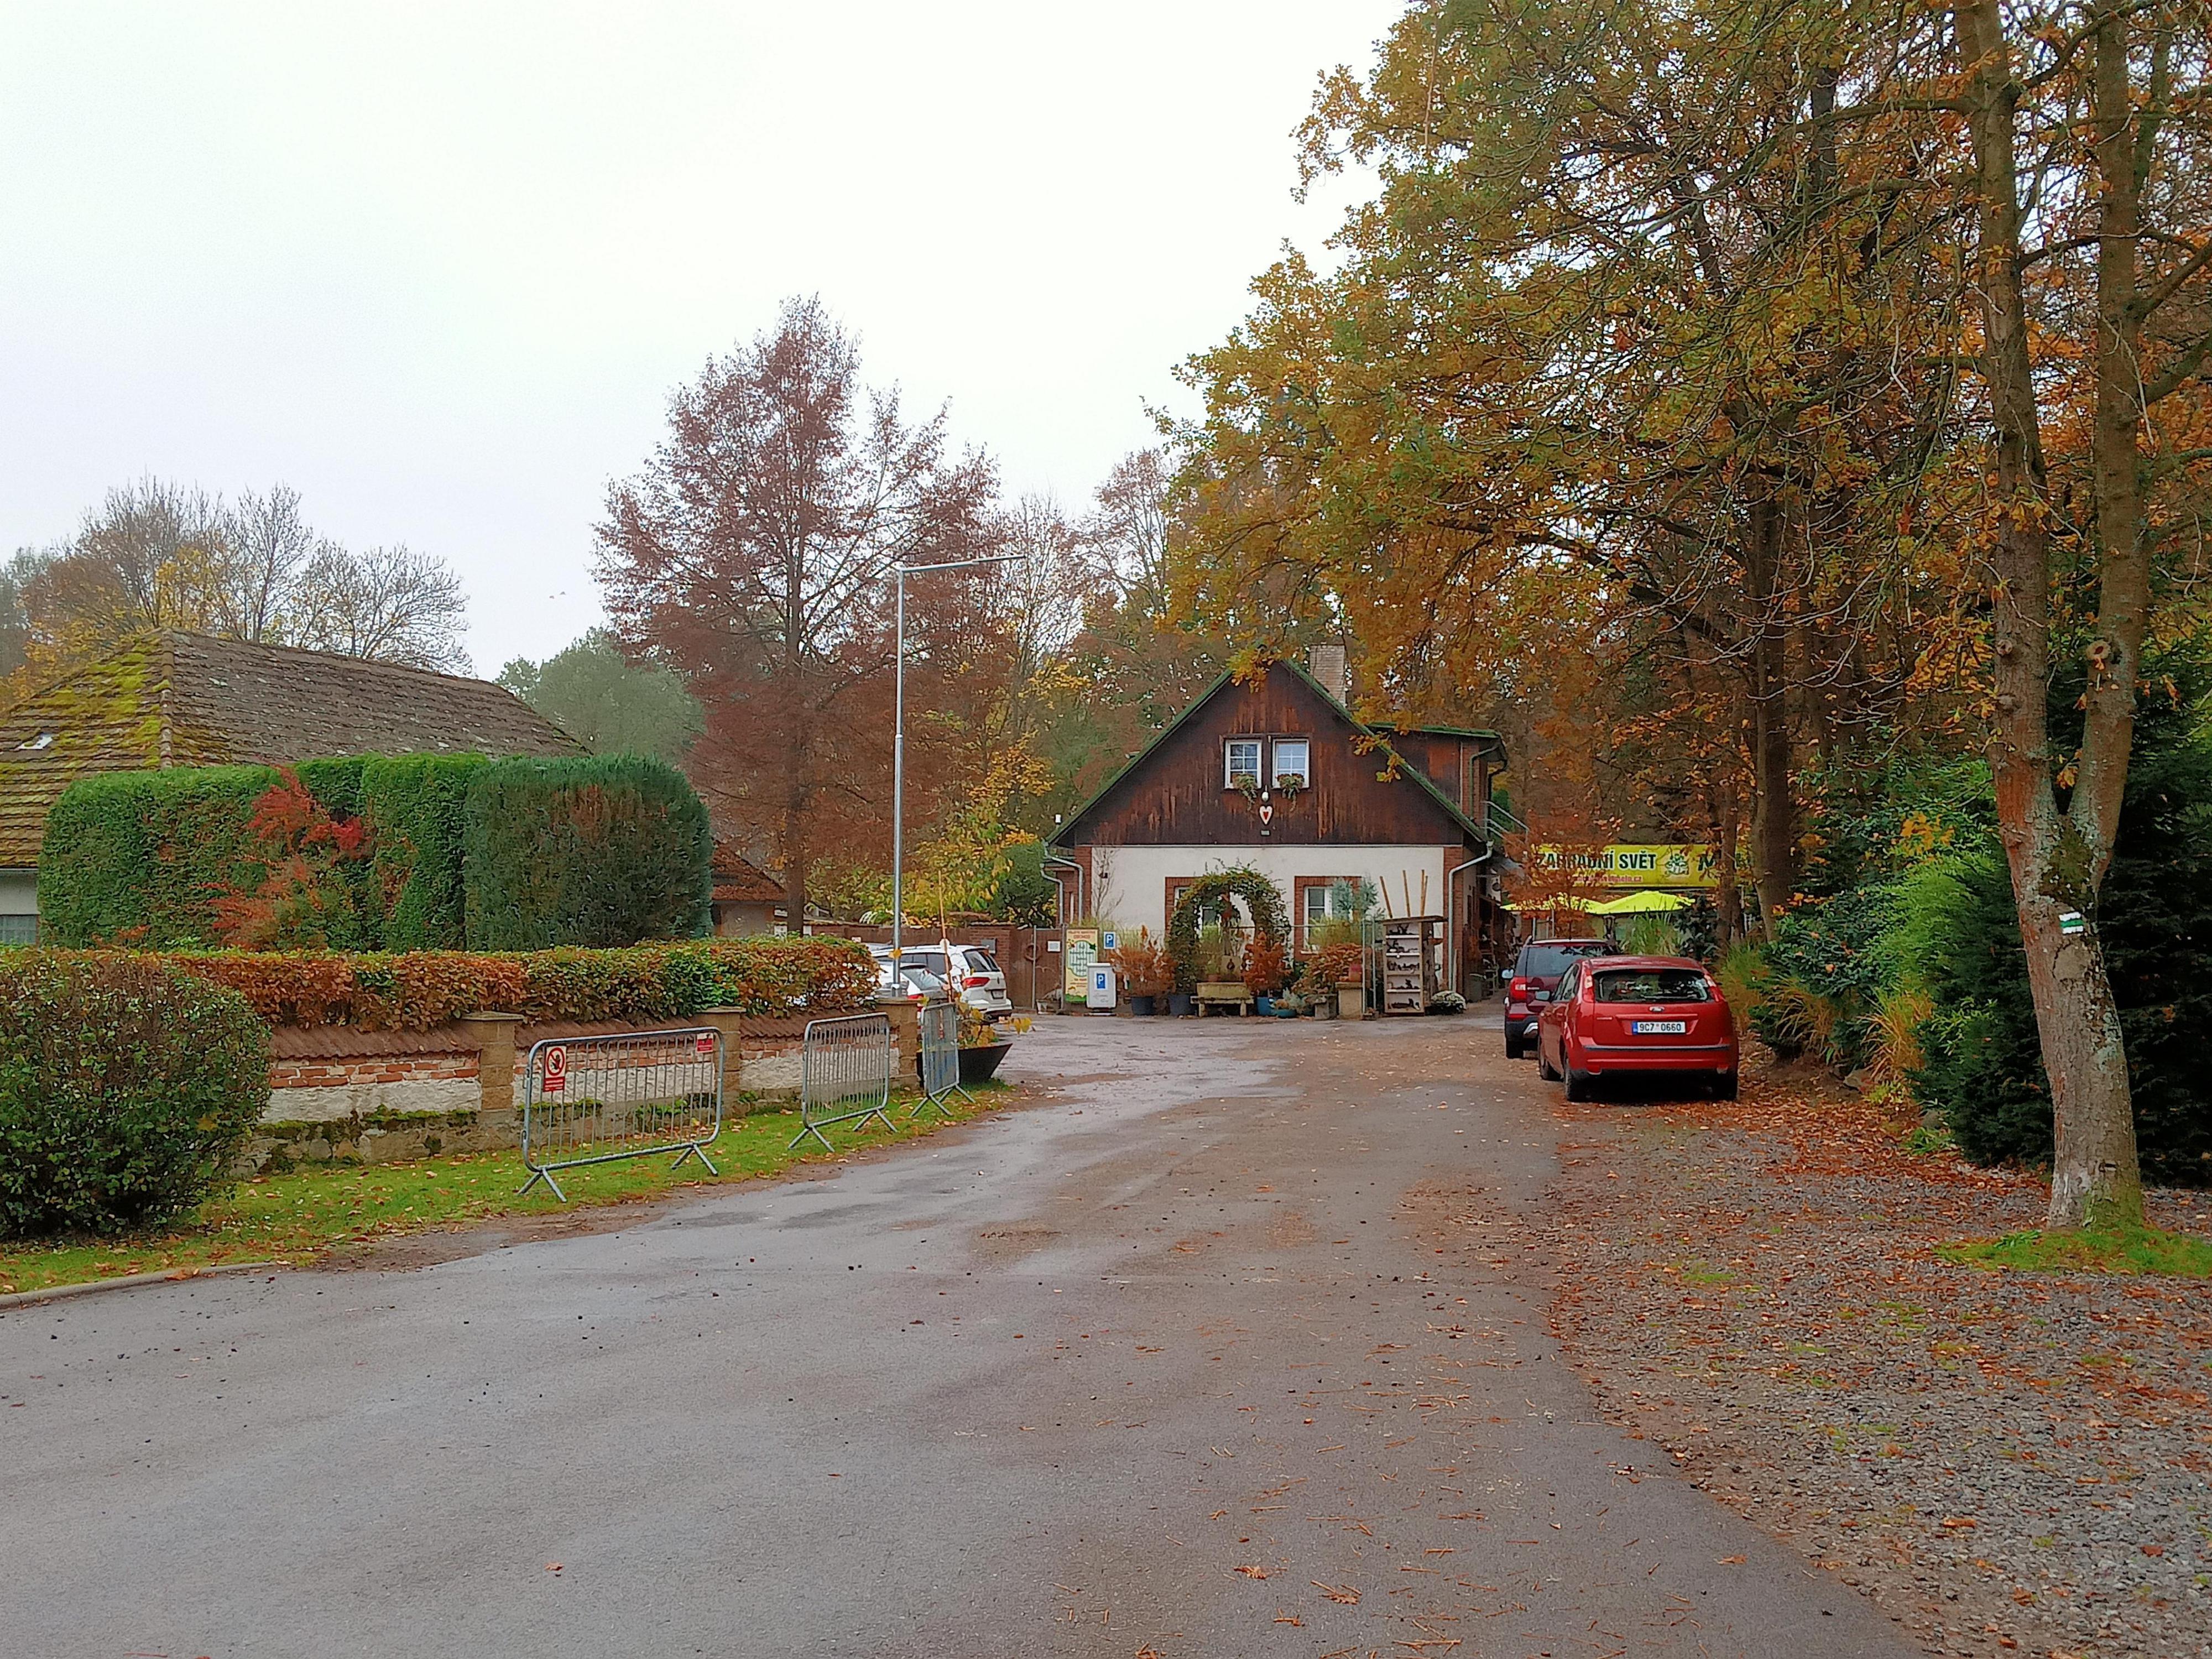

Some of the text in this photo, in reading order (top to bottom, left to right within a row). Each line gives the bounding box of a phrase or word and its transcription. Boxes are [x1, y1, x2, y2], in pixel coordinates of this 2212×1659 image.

[1619, 851, 1656, 869] SVĚT
[1107, 935, 1113, 943] P
[1098, 974, 1104, 984] P
[1639, 1023, 1682, 1031] 9C7 0660
